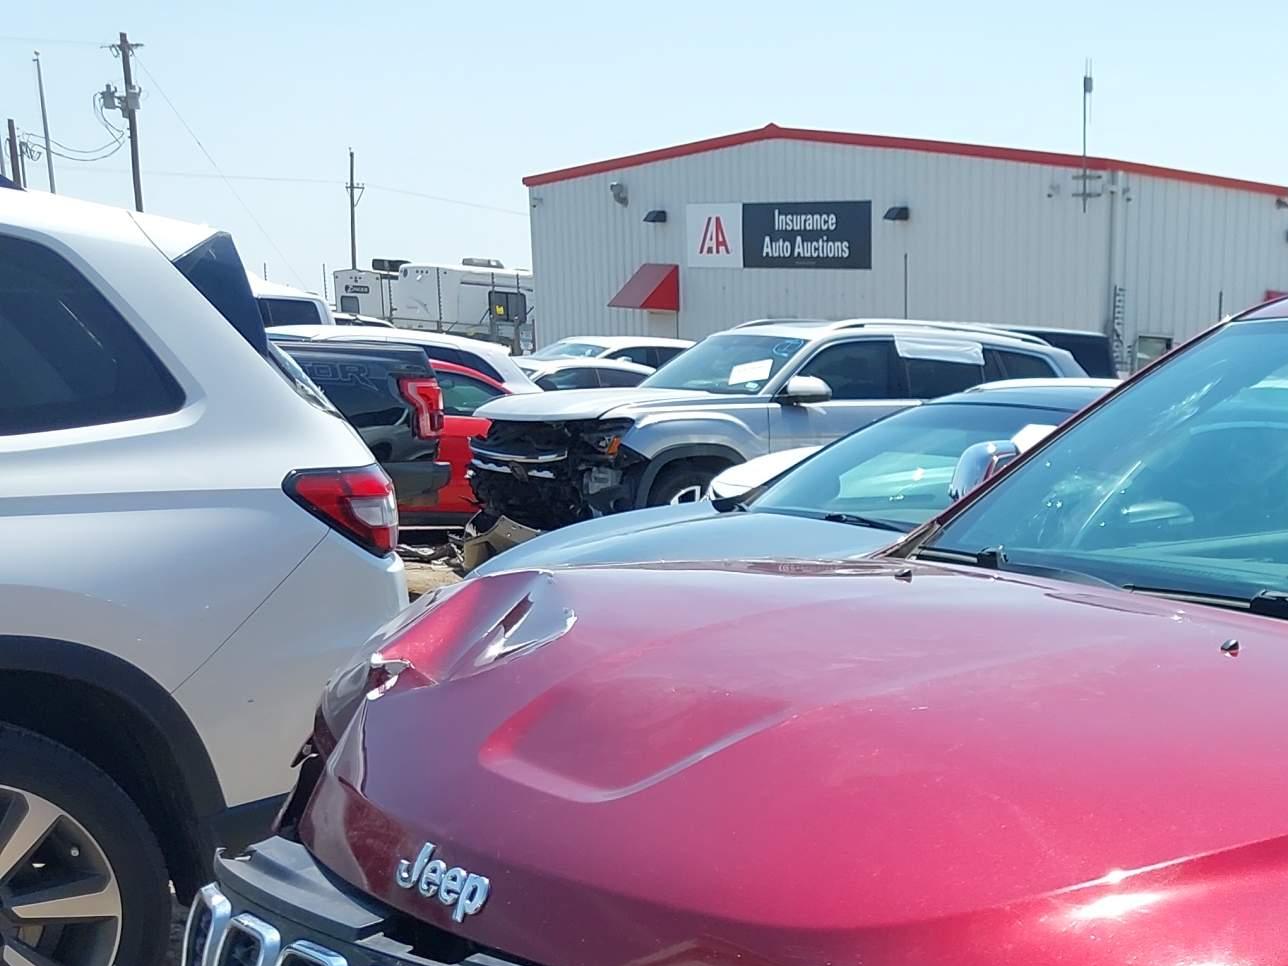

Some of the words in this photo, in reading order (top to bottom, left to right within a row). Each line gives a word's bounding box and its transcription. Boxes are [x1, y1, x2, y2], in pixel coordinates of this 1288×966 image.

[774, 209, 837, 231] Insurance
[763, 235, 791, 257] Auto
[794, 235, 849, 258] Auctions
[396, 841, 490, 923] Jeep
